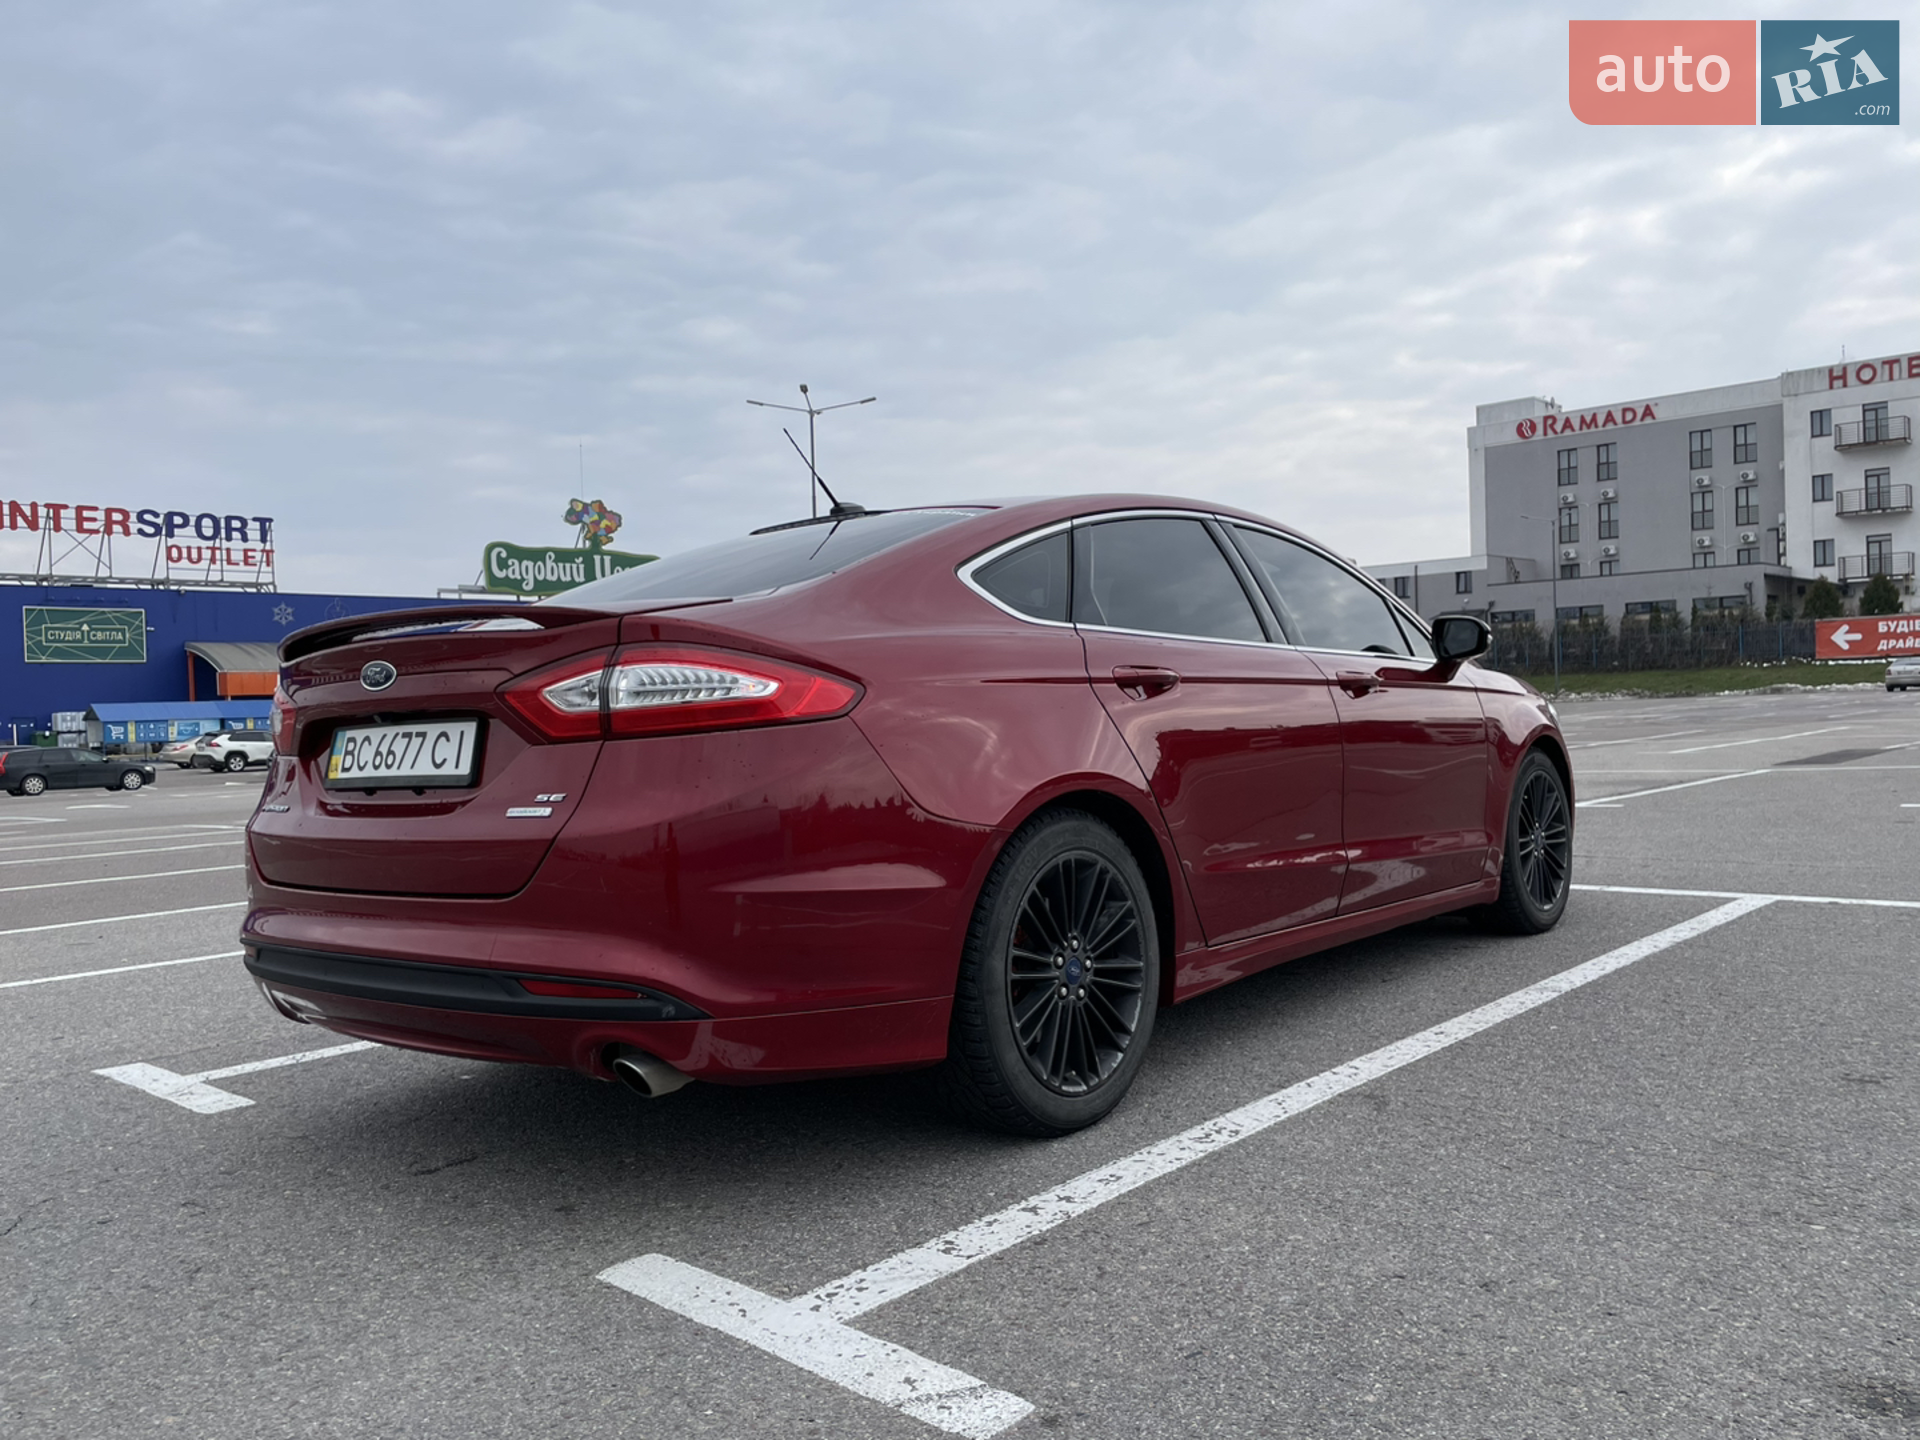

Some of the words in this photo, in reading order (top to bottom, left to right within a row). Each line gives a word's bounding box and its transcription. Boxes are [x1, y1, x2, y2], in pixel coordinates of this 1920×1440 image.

[1828, 355, 1920, 390] HOTE
[1542, 403, 1657, 437] RAMADA
[166, 544, 275, 567] OUTLET
[490, 547, 586, 591] Садовий
[47, 630, 82, 641] СТУДІЯ
[90, 630, 124, 641] СВІТЛА
